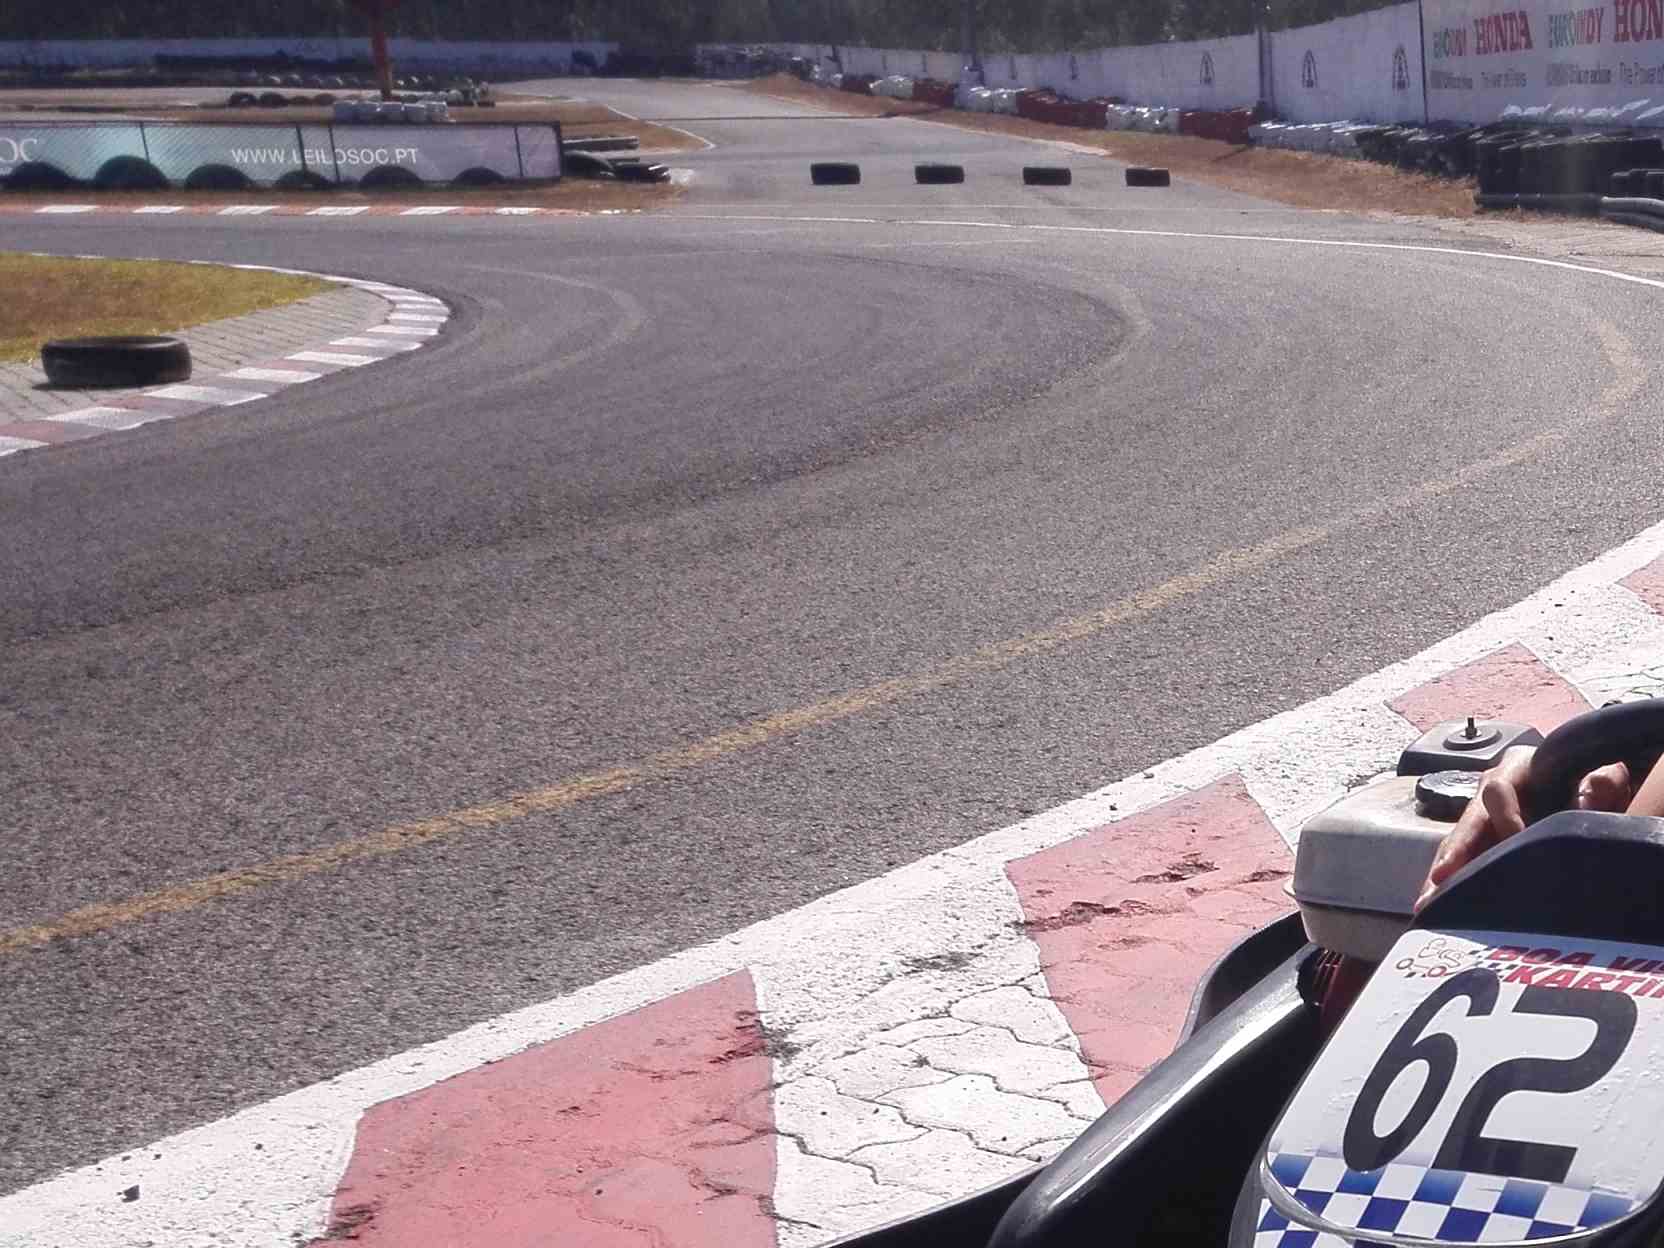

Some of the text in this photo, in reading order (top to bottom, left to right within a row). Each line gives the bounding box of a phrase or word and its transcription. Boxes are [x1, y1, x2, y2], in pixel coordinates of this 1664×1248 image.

[1474, 10, 1534, 55] HONDA
[231, 148, 418, 166] WWW.LEILOSOC.PT
[1486, 944, 1595, 968] BOA
[1342, 967, 1638, 1184] 62
